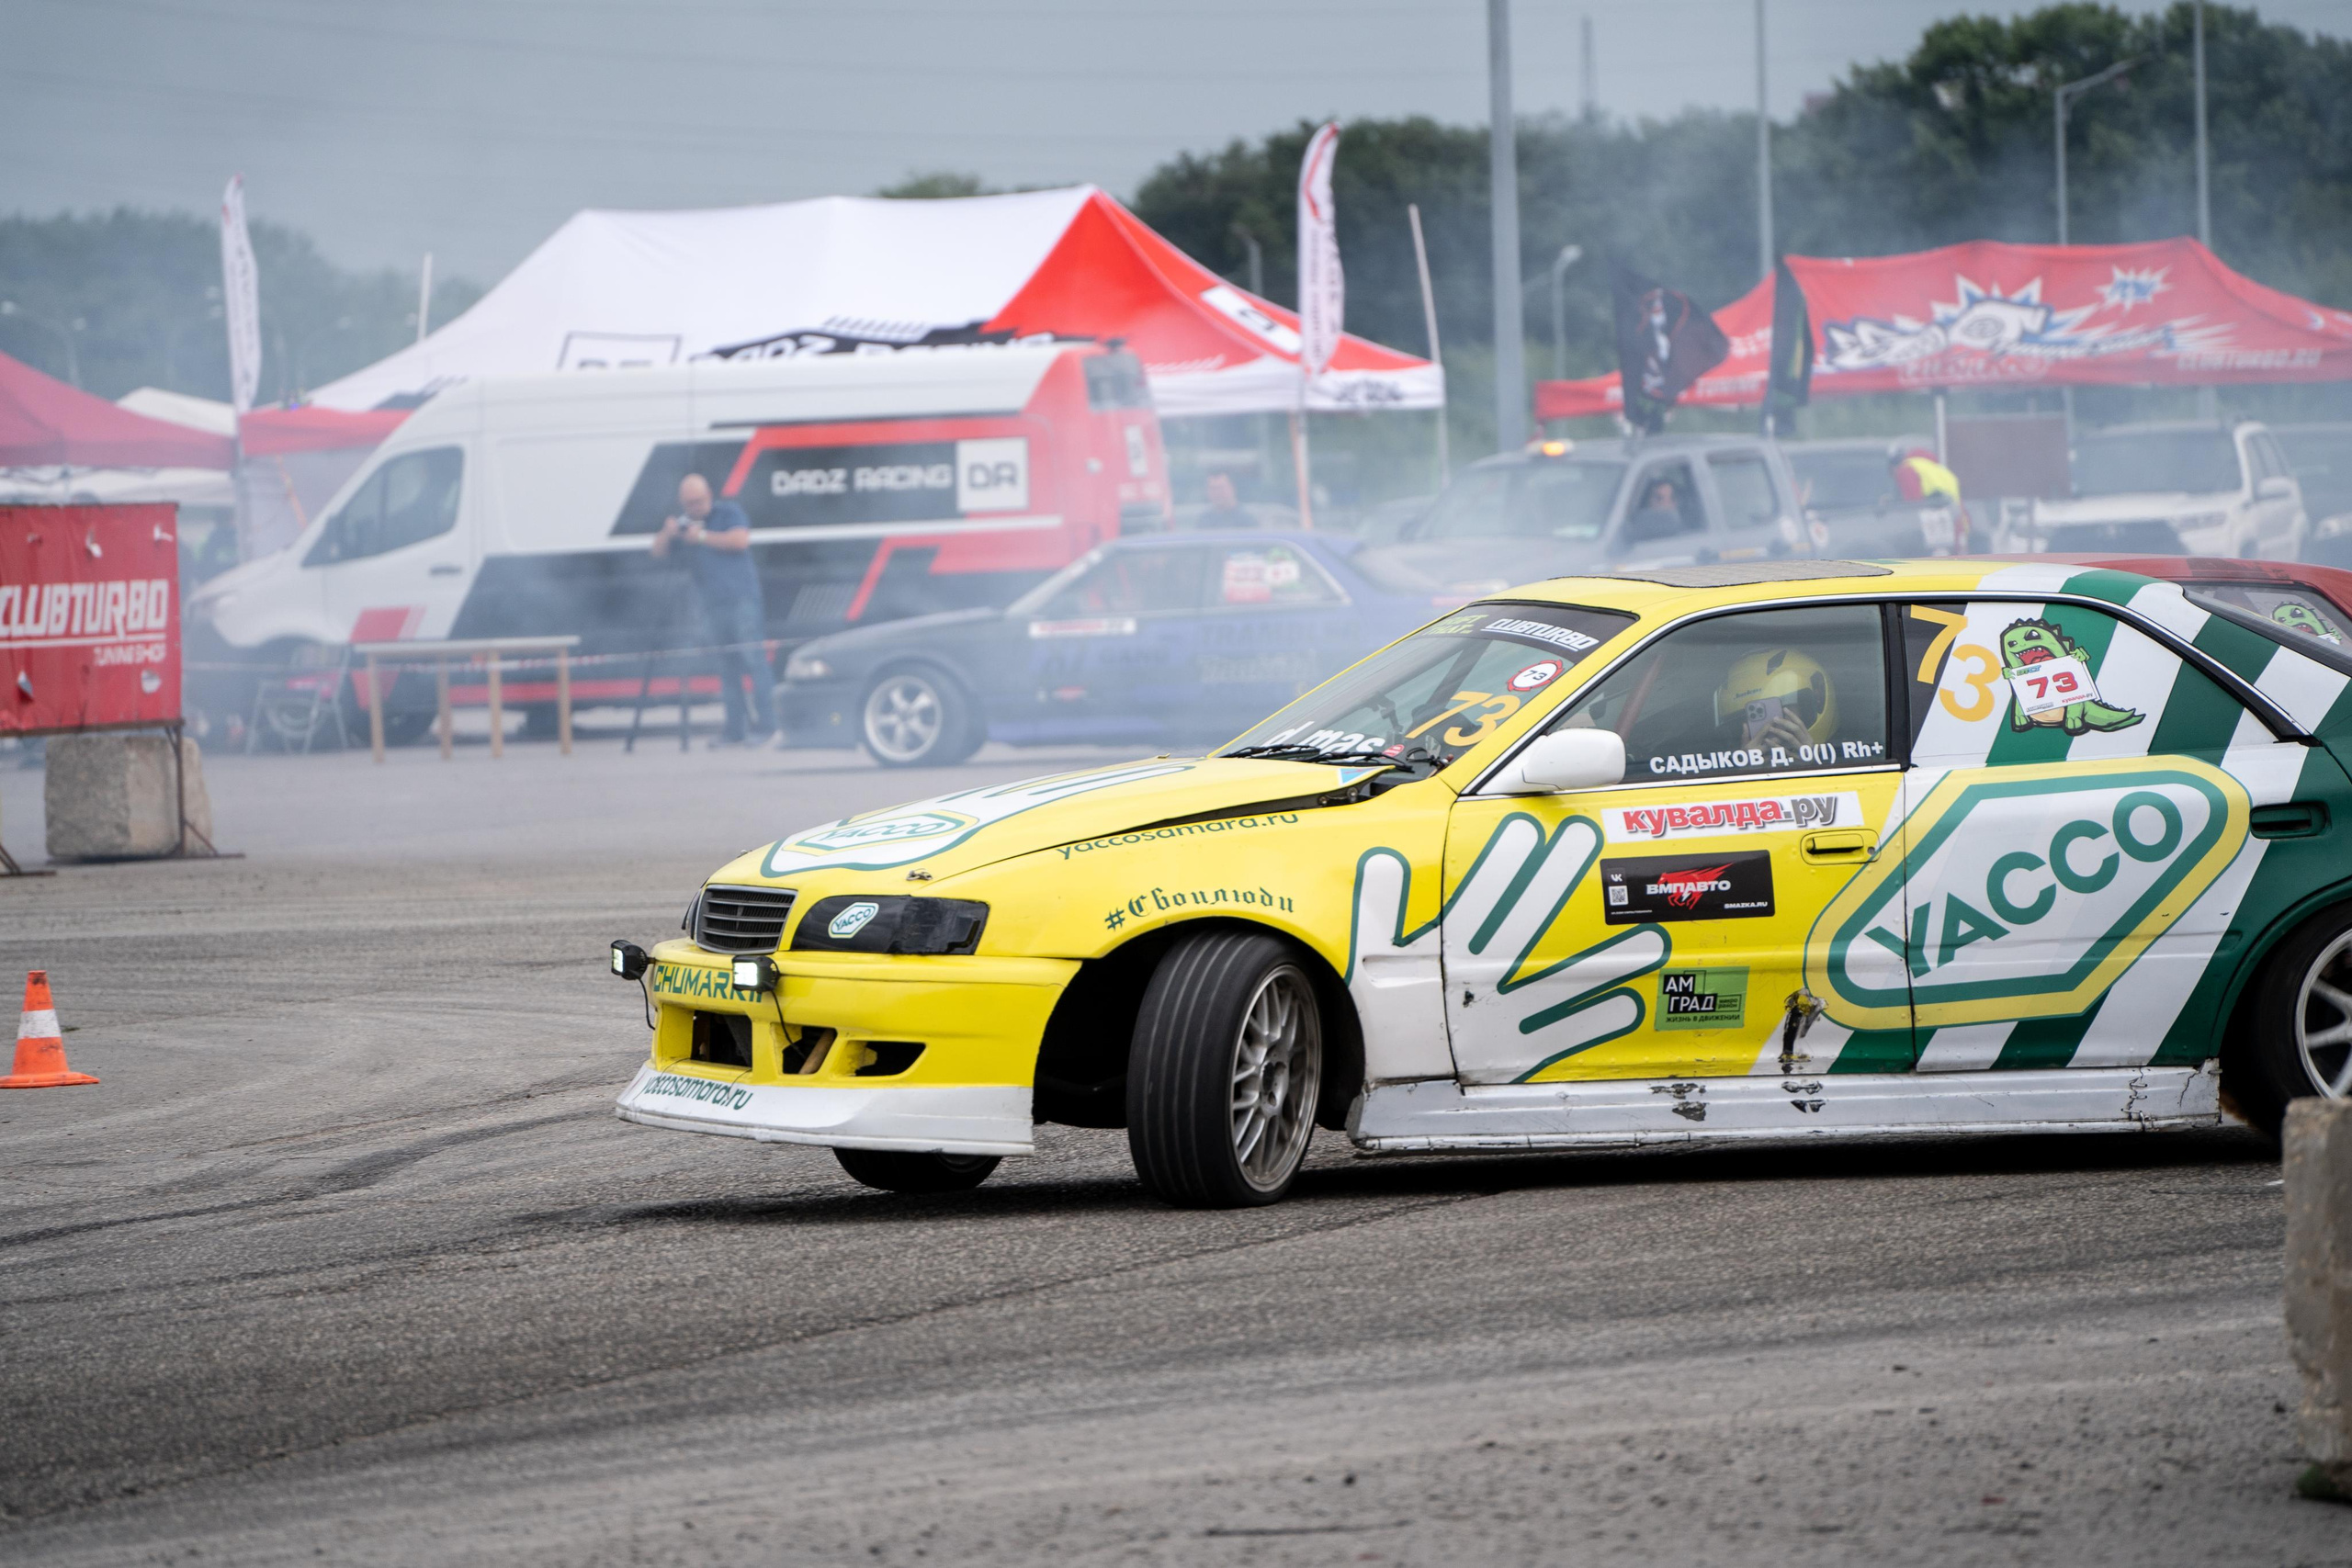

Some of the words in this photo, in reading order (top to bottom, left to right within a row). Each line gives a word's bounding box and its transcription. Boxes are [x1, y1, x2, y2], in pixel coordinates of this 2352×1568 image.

[771, 467, 847, 496] DADZ
[853, 463, 953, 491] RACING
[967, 461, 1017, 490] DR
[0, 579, 169, 639] CLUBTURBO
[1485, 618, 1600, 650] CLUBTURBO
[1523, 670, 1547, 681] 73
[1909, 604, 2000, 722] 73
[2027, 671, 2078, 699] 73
[1406, 691, 1521, 747] 73
[1649, 749, 1764, 774] САДЫКОВ
[1770, 747, 1793, 766] Д.
[1842, 740, 1883, 759] Rh+
[1623, 795, 1837, 837] кувалда.ру
[819, 822, 946, 841] YACCO
[1057, 813, 1299, 860] yaccosamara.ru
[1646, 880, 1731, 897] ВМПАВТО
[1865, 791, 2183, 978] YACCO
[834, 908, 871, 931] YACCO
[1724, 901, 1768, 909] SMAZKA.RU
[1665, 976, 1693, 992] АМ
[1669, 995, 1714, 1011] ГРАД
[1698, 1014, 1740, 1022] ДВИЖЕНИИ
[644, 1075, 753, 1111] yaccosamara.ru
